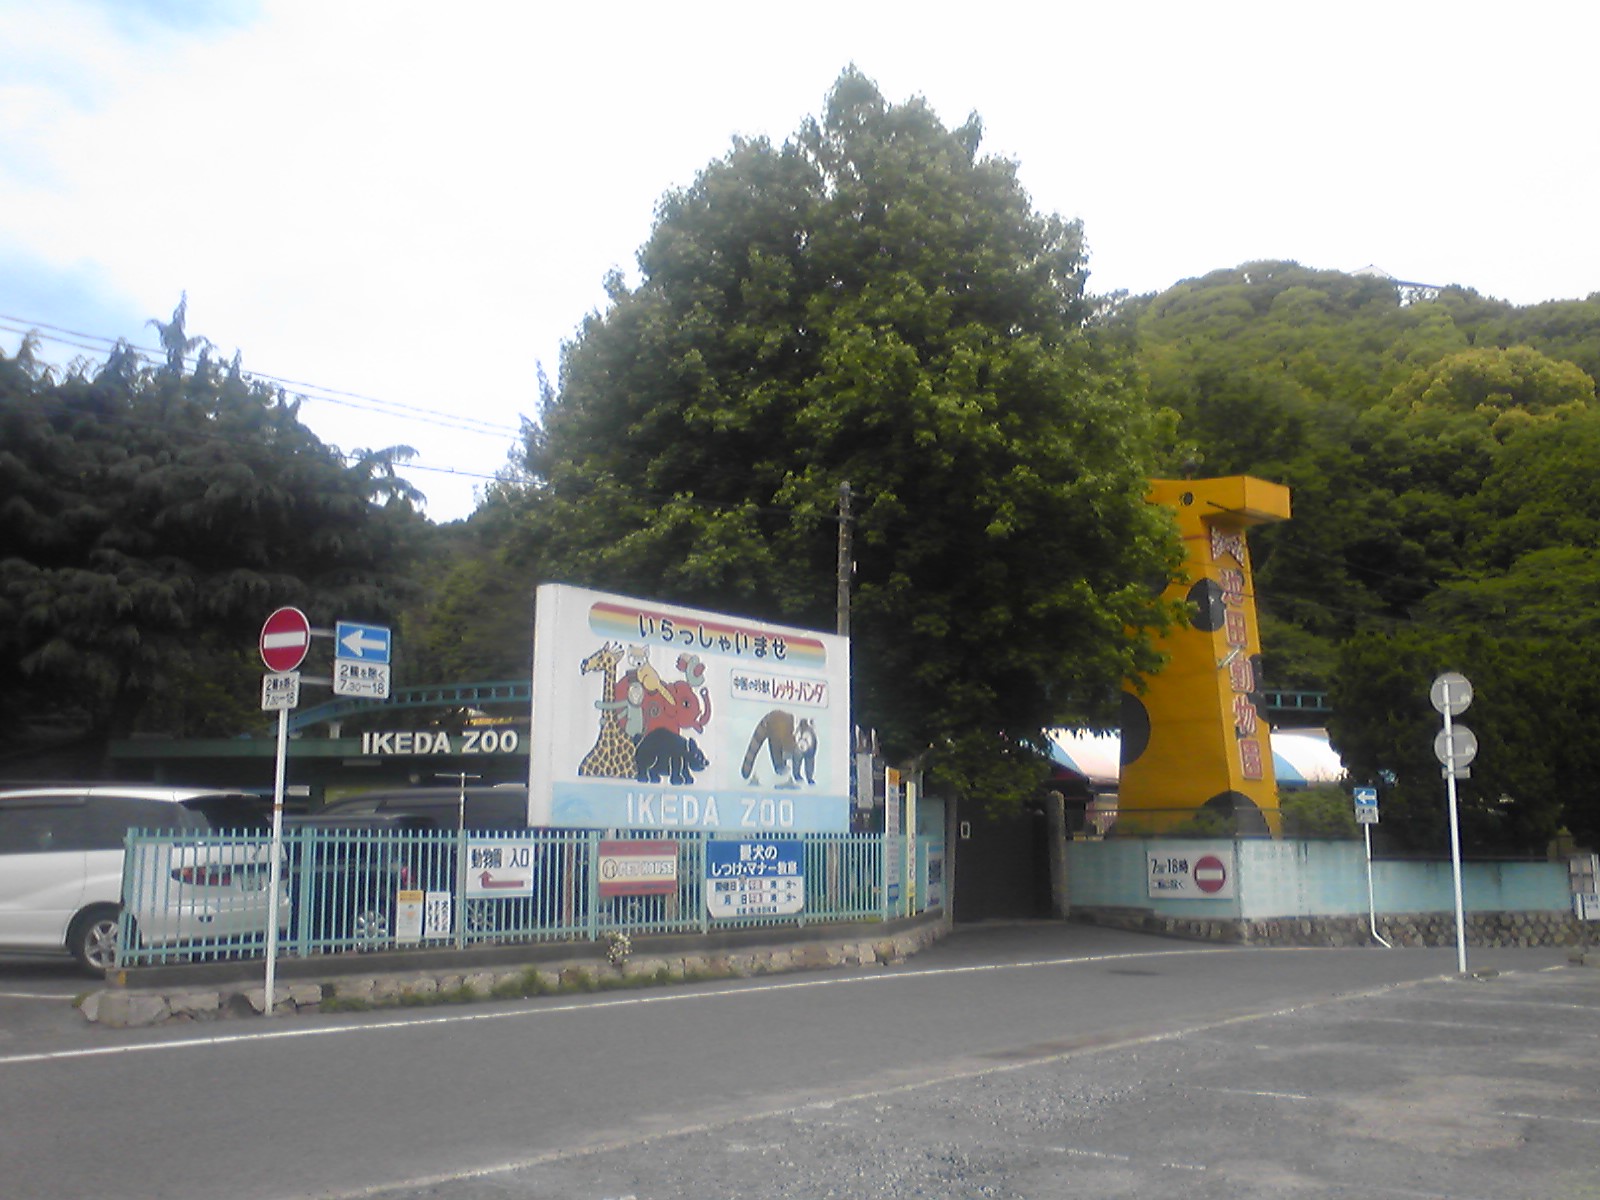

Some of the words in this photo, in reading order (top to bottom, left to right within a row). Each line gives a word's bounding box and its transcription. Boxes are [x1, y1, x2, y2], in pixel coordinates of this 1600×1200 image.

[638, 614, 786, 660] いらっしゃいませ
[362, 731, 451, 754] IKEDA
[461, 730, 518, 753] ZOO
[627, 793, 719, 826] IKEDA
[740, 799, 794, 827] ZOO
[510, 848, 529, 868] 入口
